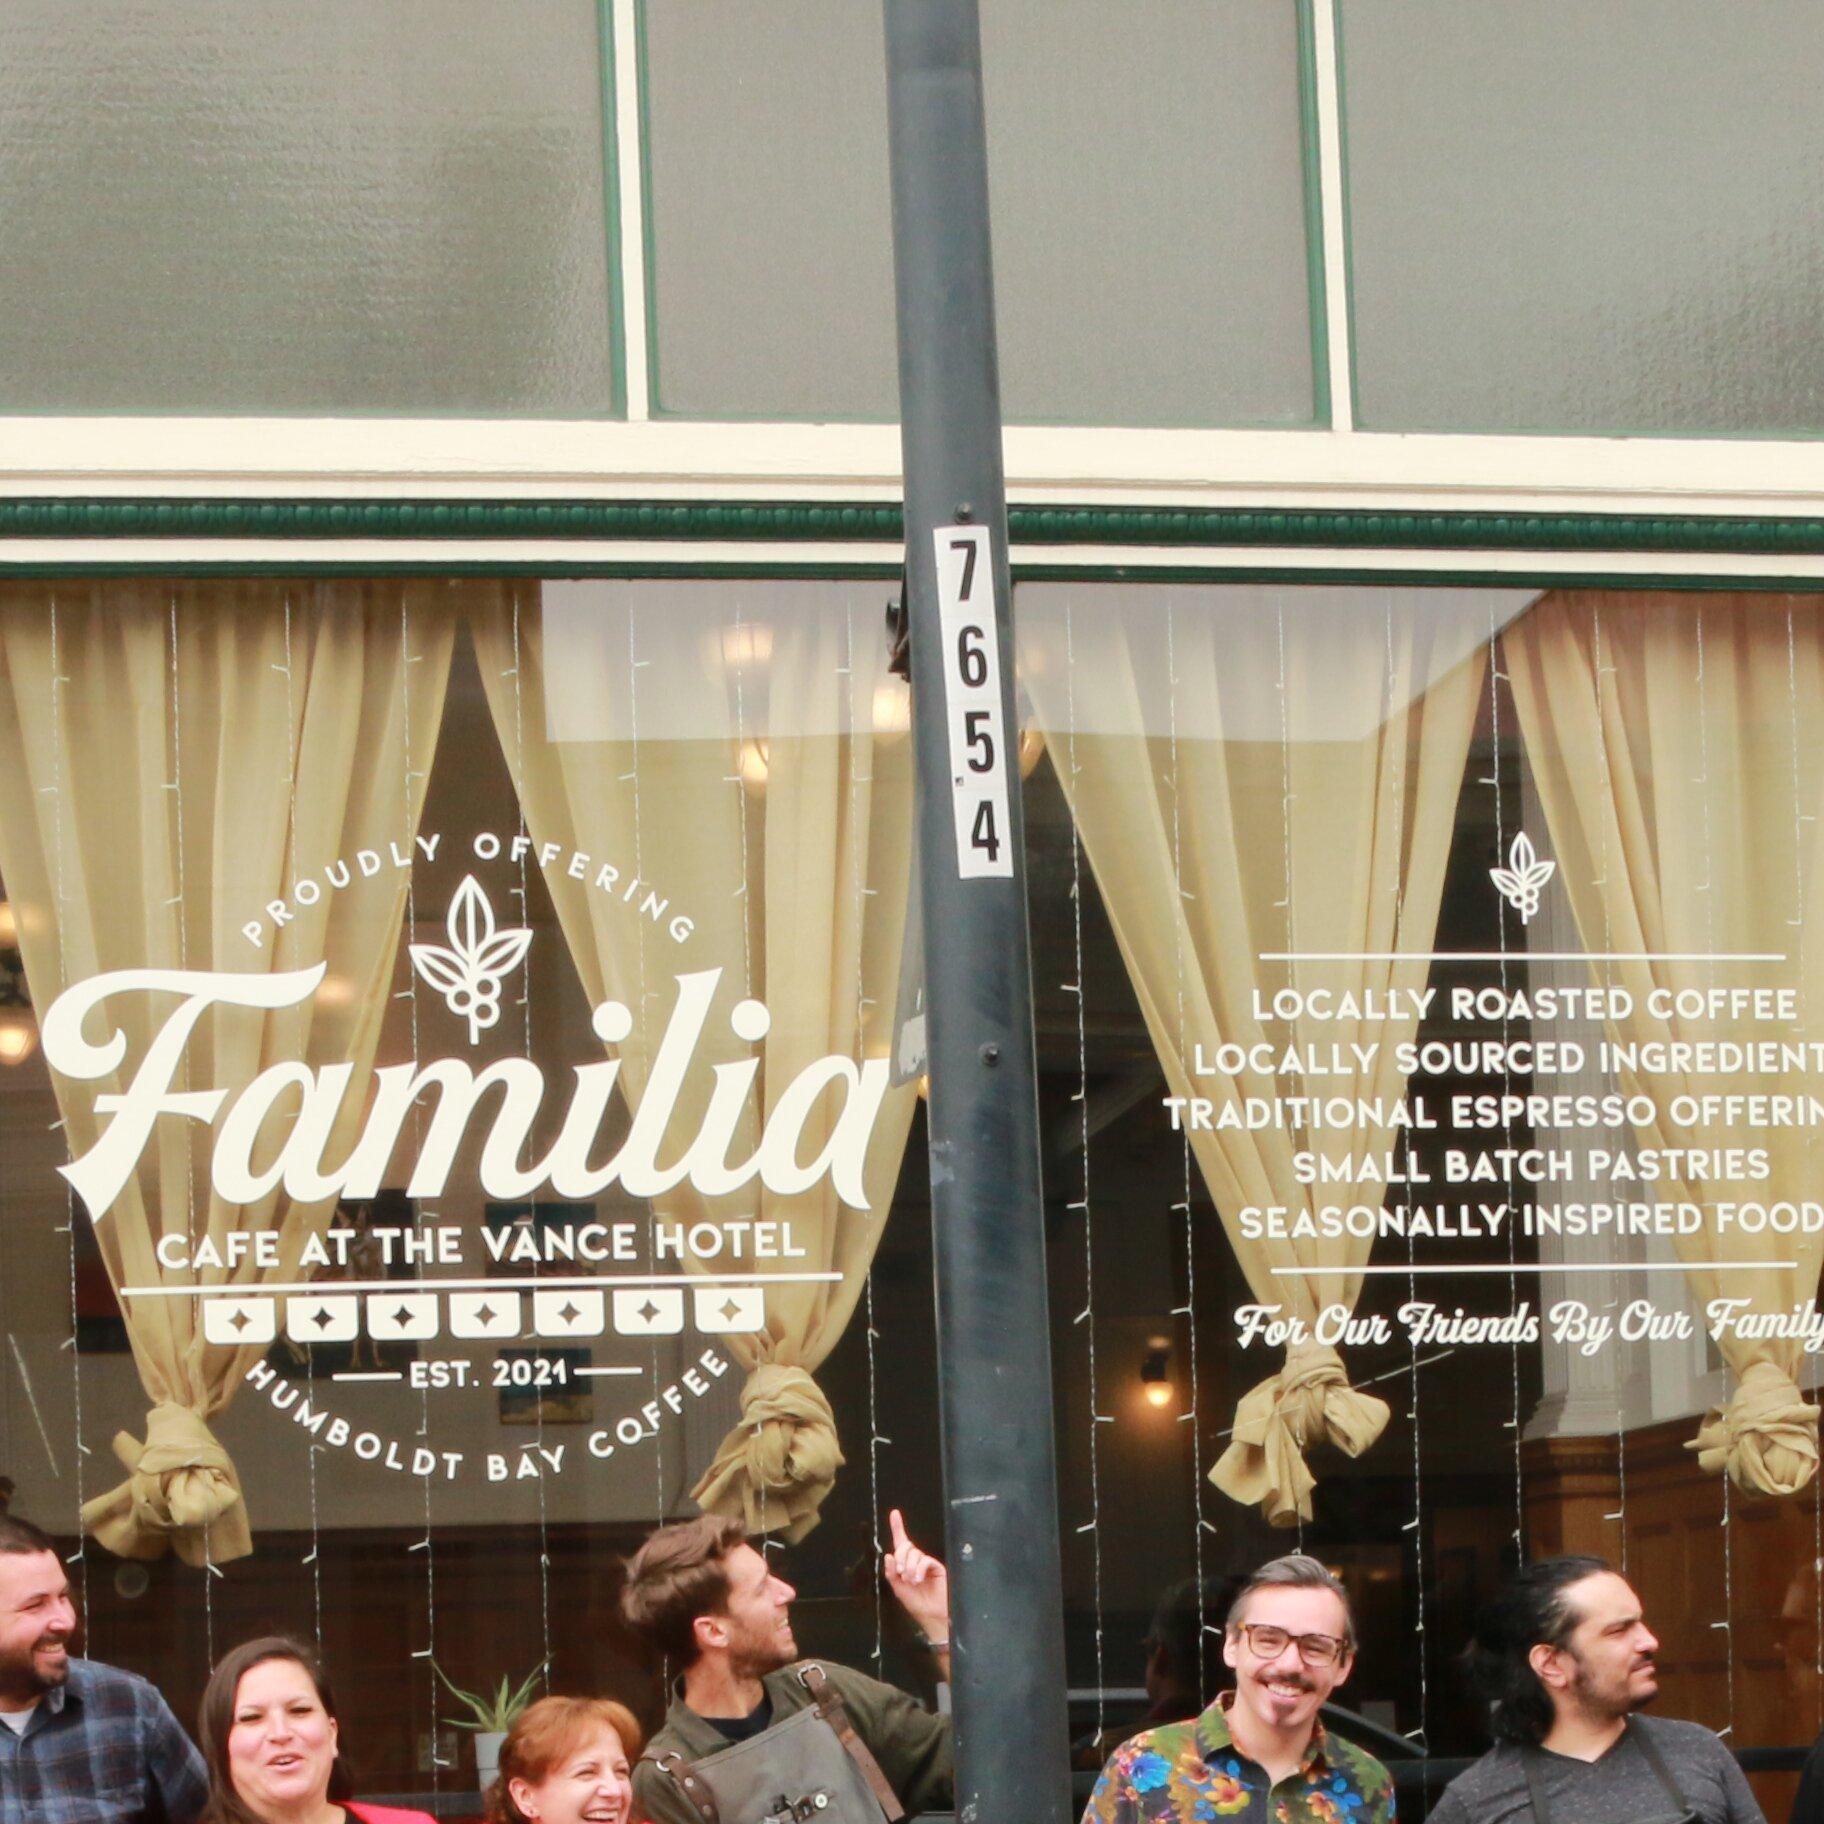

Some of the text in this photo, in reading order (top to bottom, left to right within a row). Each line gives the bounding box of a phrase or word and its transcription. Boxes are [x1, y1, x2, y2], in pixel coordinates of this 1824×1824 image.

[949, 540, 999, 863] 7654
[241, 833, 695, 950] PROUDLY OFFERING
[1252, 987, 1798, 1021] LOCALLY ROASTED COFFEE
[1194, 1043, 1379, 1075] LOCALLY
[1395, 1041, 1585, 1074] SOURCED
[41, 959, 891, 1224] Familia
[1162, 1096, 1437, 1130] TRADITIONAL
[1452, 1095, 1656, 1128] ESPRESSO
[1292, 1148, 1770, 1183] SMALL BATCH PASTRIES
[1239, 1204, 1507, 1239] SEASONALLY
[1524, 1203, 1702, 1236] INSPIRED
[157, 1222, 806, 1269] CAFE AT THE VANCE HOTEL
[1234, 1304, 1309, 1349] For
[1315, 1304, 1391, 1346] Our
[1398, 1302, 1539, 1346] Friends
[1549, 1300, 1614, 1356] By
[1619, 1303, 1693, 1341] Our
[410, 1358, 566, 1388] EST. 2021
[246, 1349, 728, 1481] HUMBOLDT BAY COFFEE
